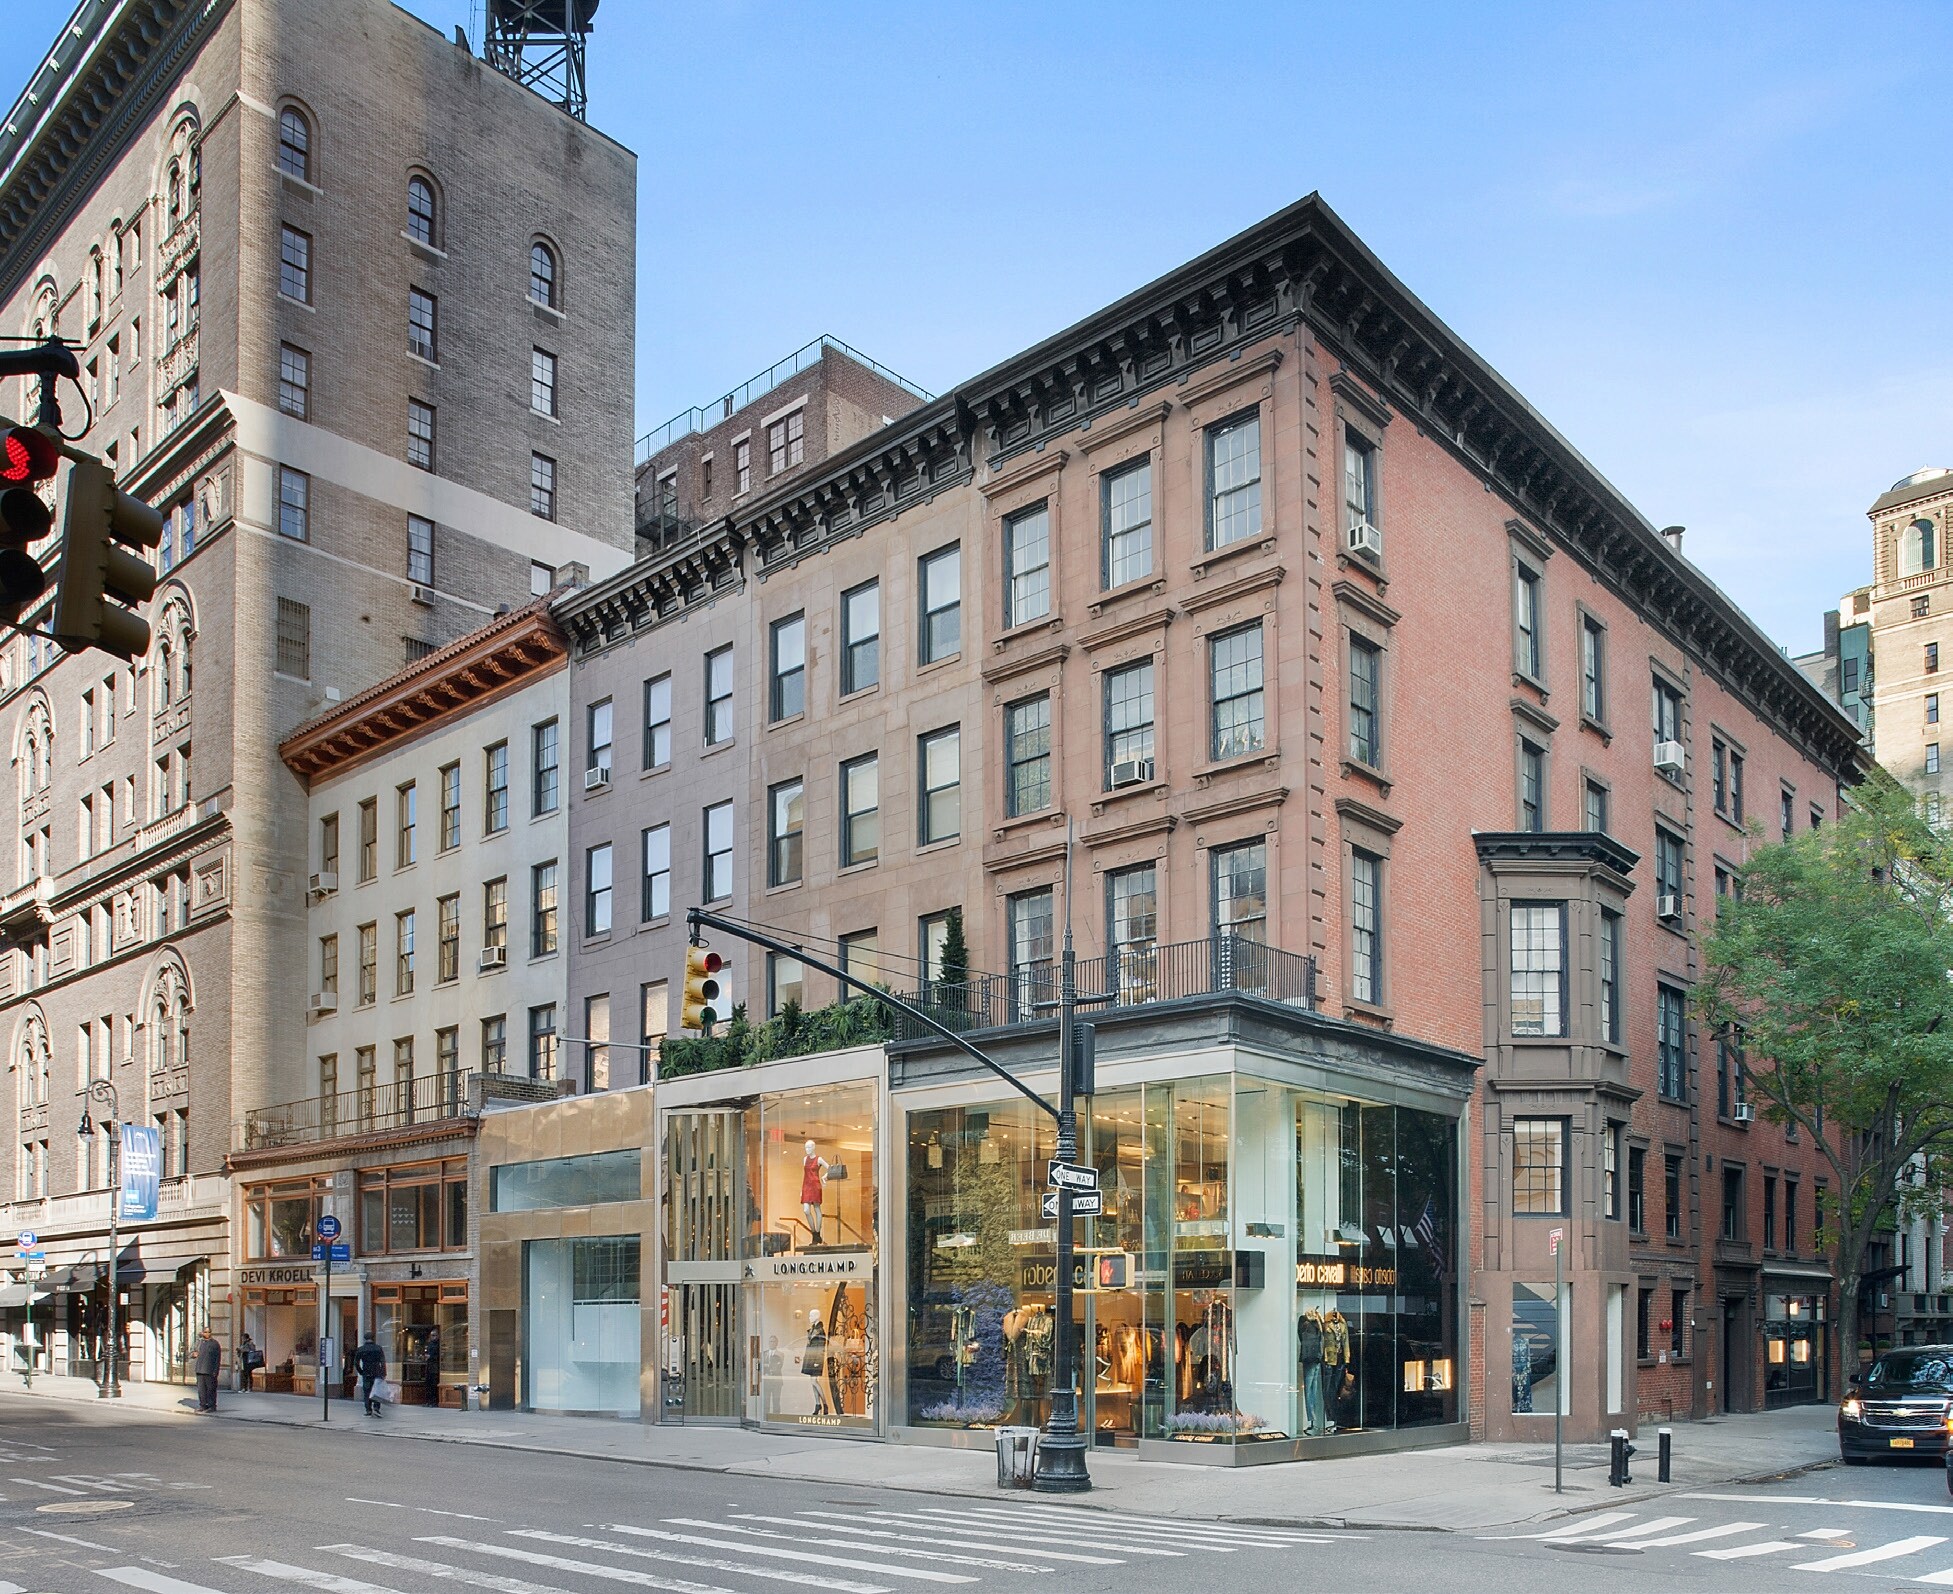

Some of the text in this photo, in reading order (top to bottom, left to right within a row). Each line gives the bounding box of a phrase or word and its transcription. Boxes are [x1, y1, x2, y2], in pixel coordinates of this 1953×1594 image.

[1056, 1170, 1091, 1185] ONE WAY
[1049, 1199, 1096, 1210] ON WAY
[773, 1261, 857, 1275] LONGCHAMP
[1023, 1264, 1057, 1285] rober
[241, 1269, 314, 1283] DEVI KROELL
[798, 1416, 842, 1426] LONGCHAMP
